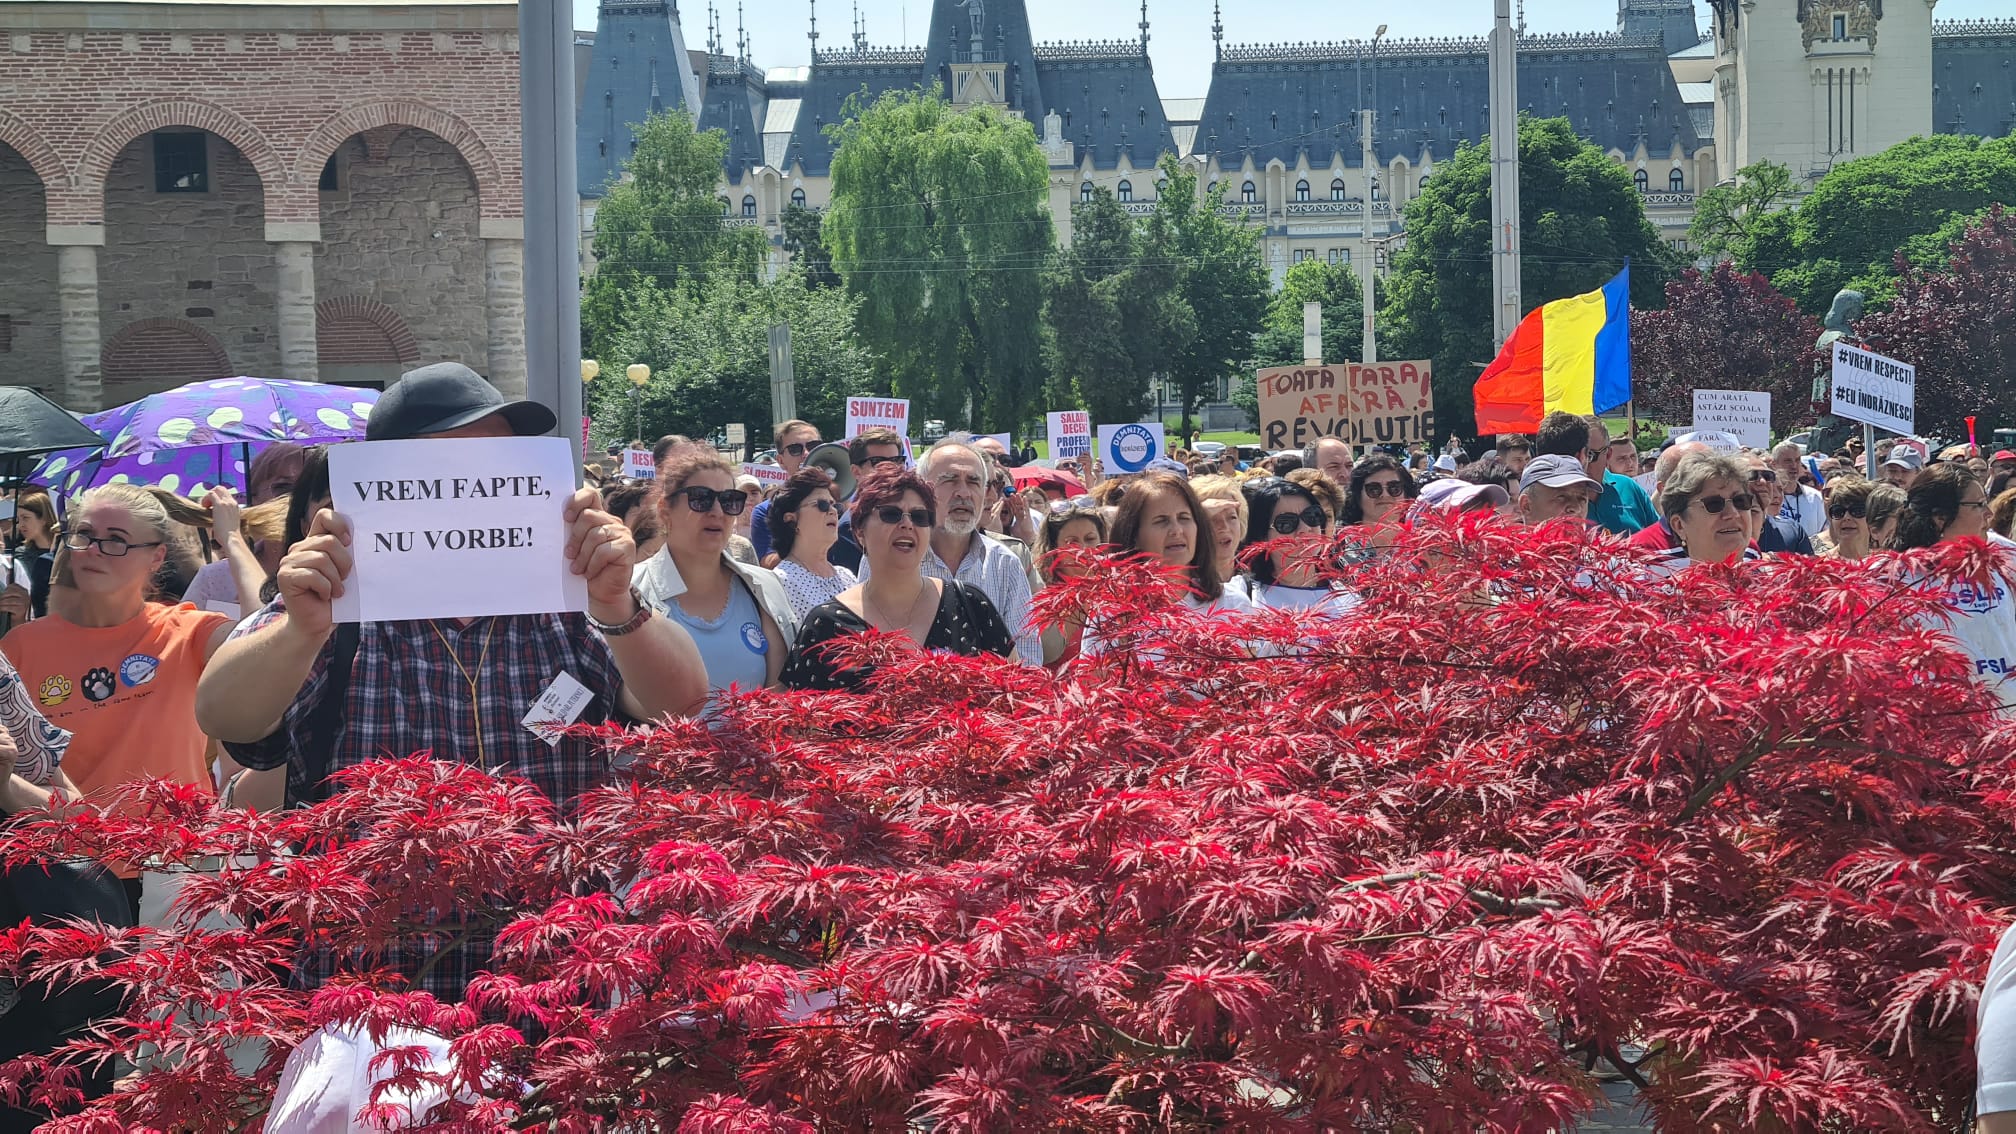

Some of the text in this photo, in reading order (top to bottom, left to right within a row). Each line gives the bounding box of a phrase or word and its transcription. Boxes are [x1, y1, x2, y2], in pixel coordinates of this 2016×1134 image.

[1838, 348, 1912, 386] #VREM RESPECT!
[1259, 368, 1335, 398] TOATA
[1835, 384, 1857, 405] #EU
[1697, 393, 1717, 401] CUM
[850, 400, 905, 419] SUNTEM
[1113, 426, 1153, 447] DEMNITATE
[353, 475, 551, 502] VREM FAPTE,
[374, 526, 533, 553] NU VORBE!
